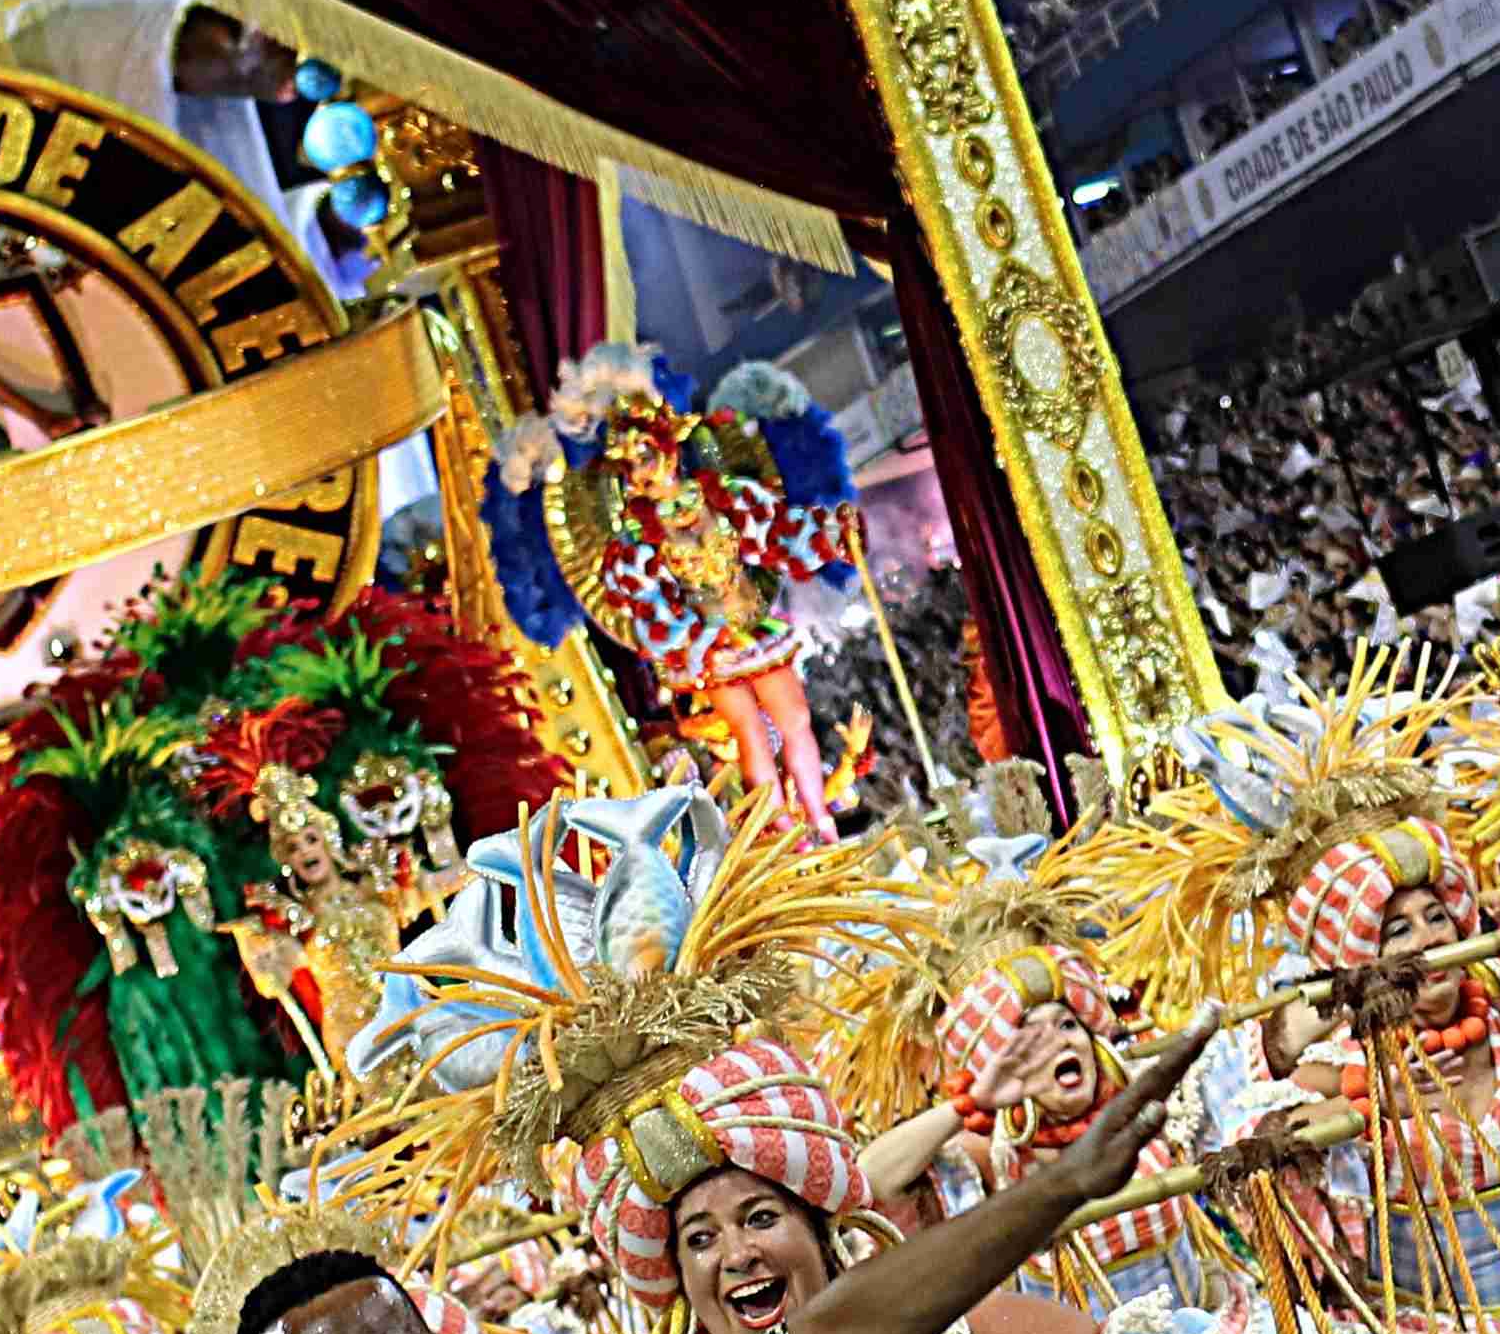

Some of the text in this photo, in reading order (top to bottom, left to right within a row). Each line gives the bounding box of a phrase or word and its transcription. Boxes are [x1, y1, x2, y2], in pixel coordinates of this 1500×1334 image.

[1223, 50, 1415, 204] CIDADE DE SÃO PAULO
